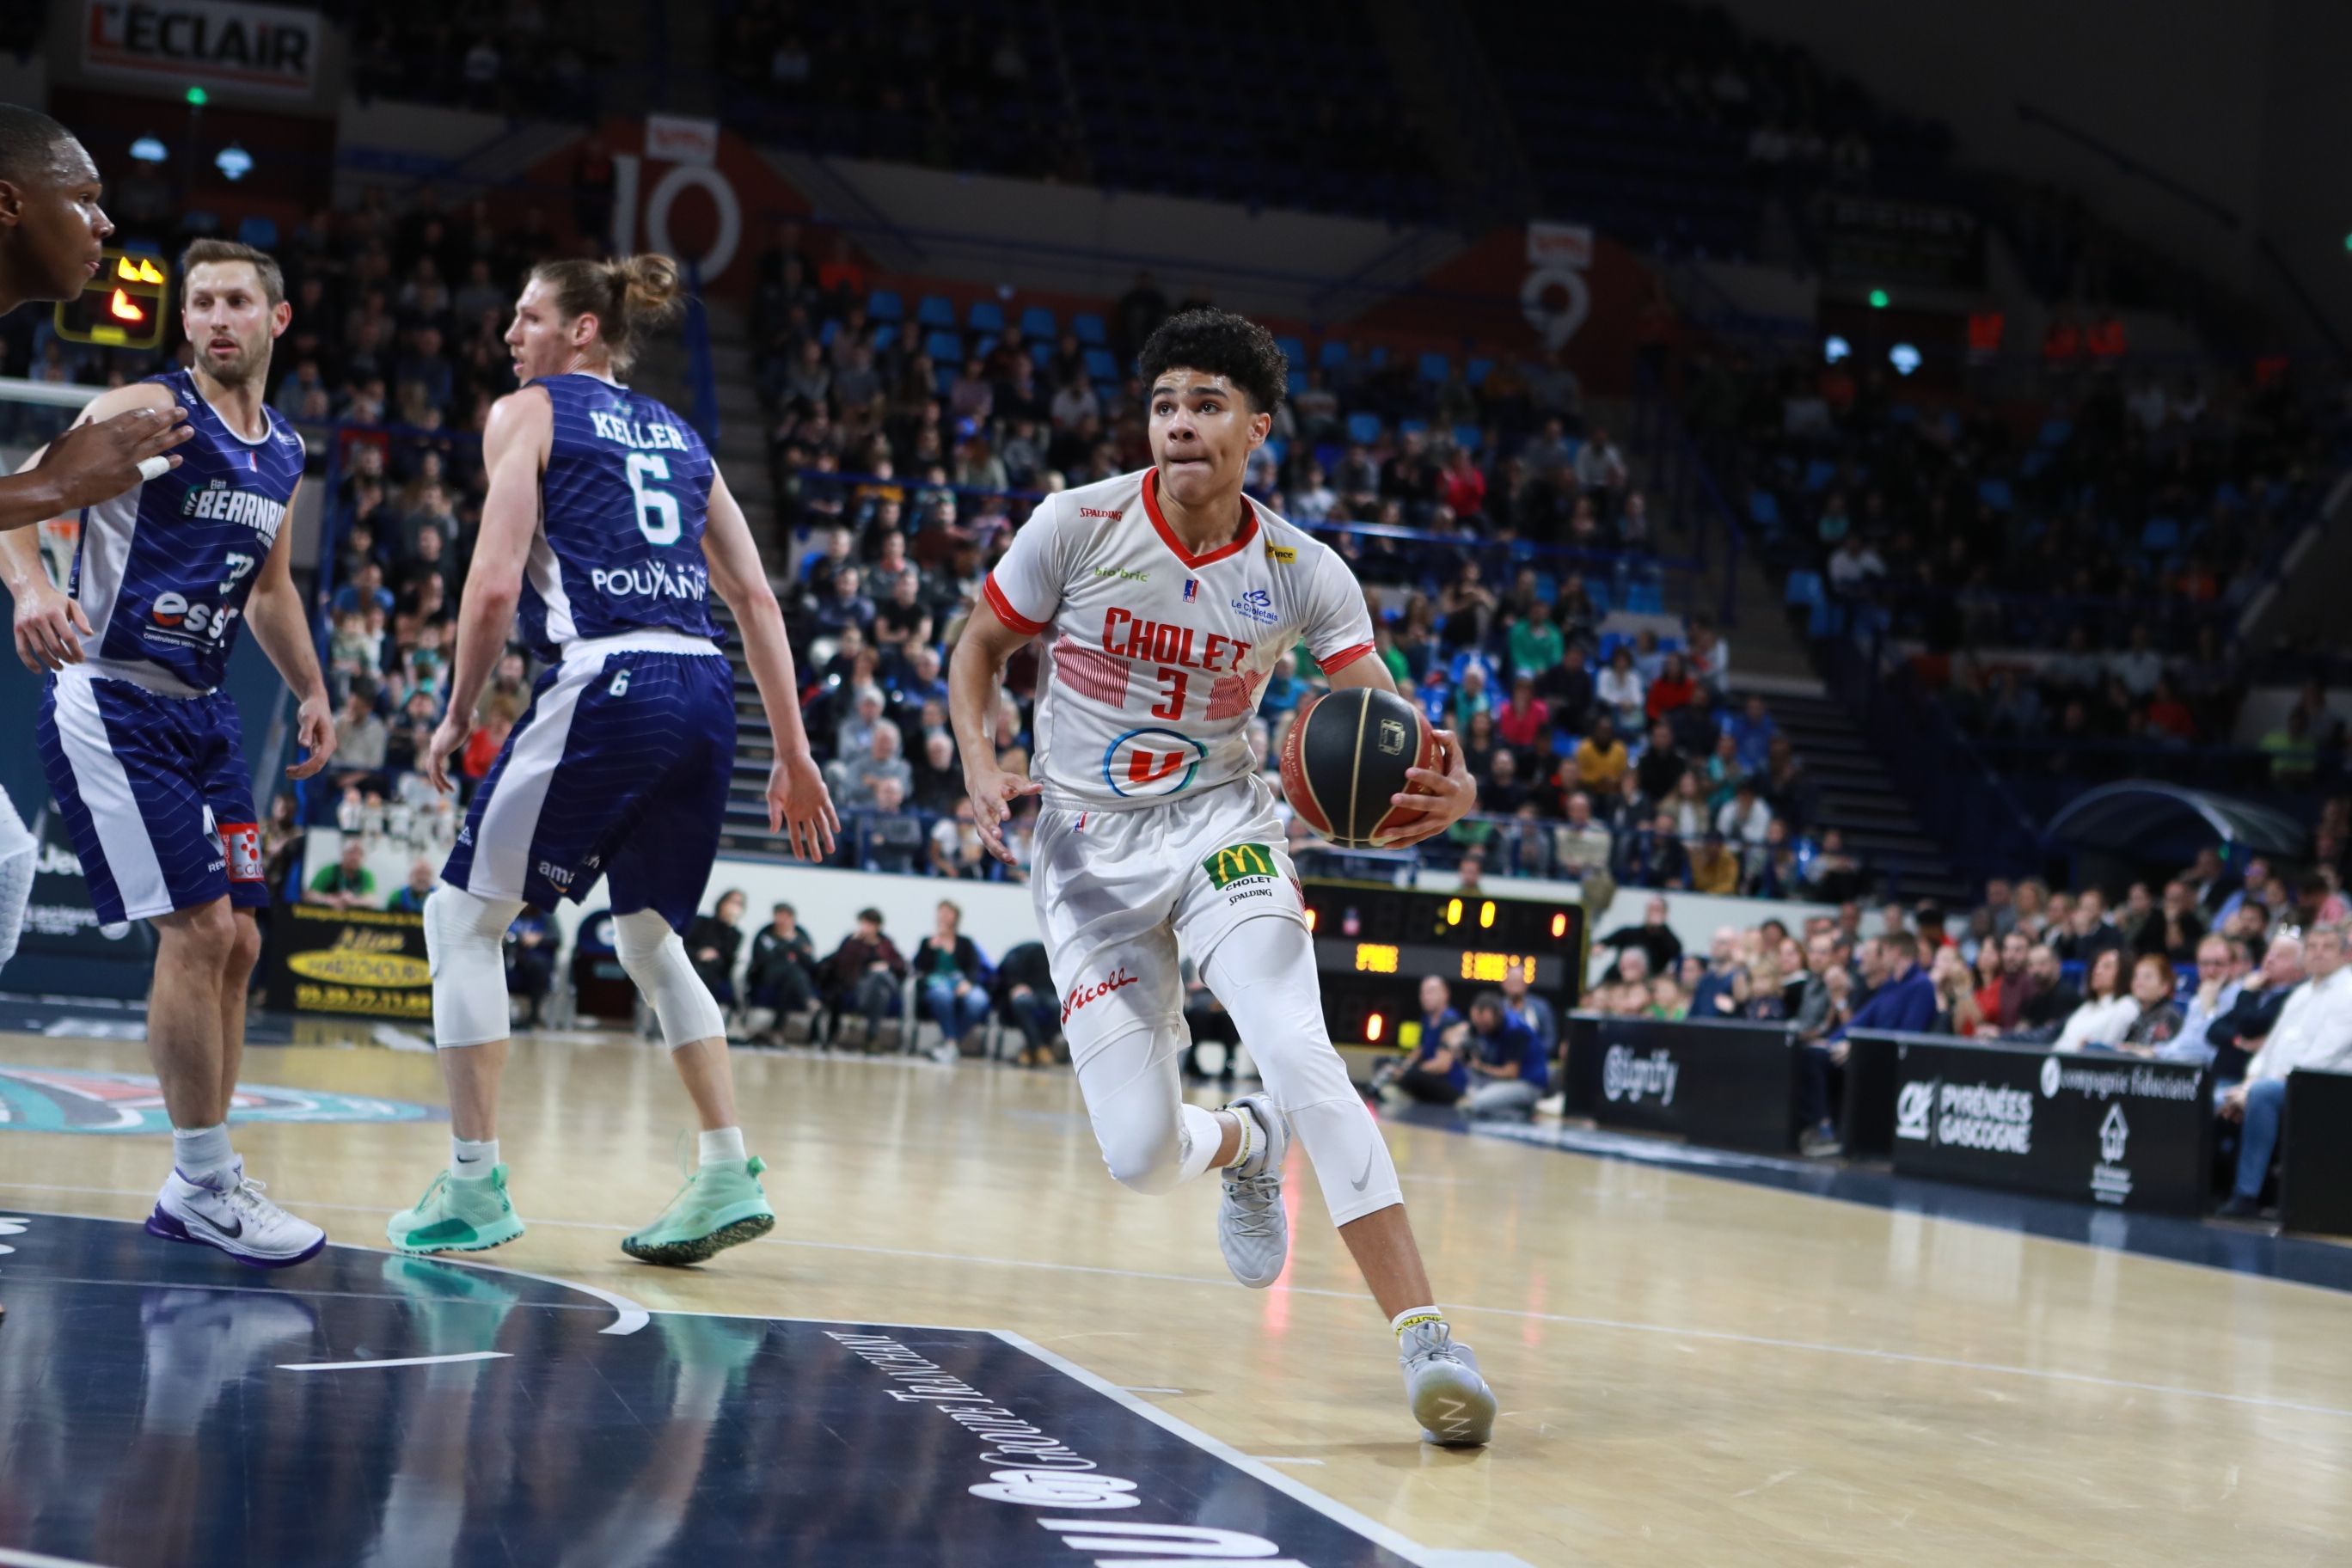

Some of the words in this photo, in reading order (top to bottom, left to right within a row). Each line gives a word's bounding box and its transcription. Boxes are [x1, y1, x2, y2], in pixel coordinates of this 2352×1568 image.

[589, 410, 688, 451] KELLER
[626, 451, 683, 546] 6
[1080, 507, 1123, 522] SPALDING
[1231, 599, 1242, 609] Le
[1102, 606, 1252, 673] CHOLET
[609, 669, 632, 697] 6
[1151, 666, 1189, 720] 3
[1225, 877, 1271, 891] CHOLET
[1228, 888, 1272, 907] SPALDING
[1061, 966, 1138, 1026] Nicoll
[1940, 1080, 2034, 1124] PYRÉNÉES
[1938, 1116, 2032, 1155] GASCOGNE
[823, 1330, 995, 1403] TRANCHANT
[935, 1406, 1098, 1470] GROUPE
